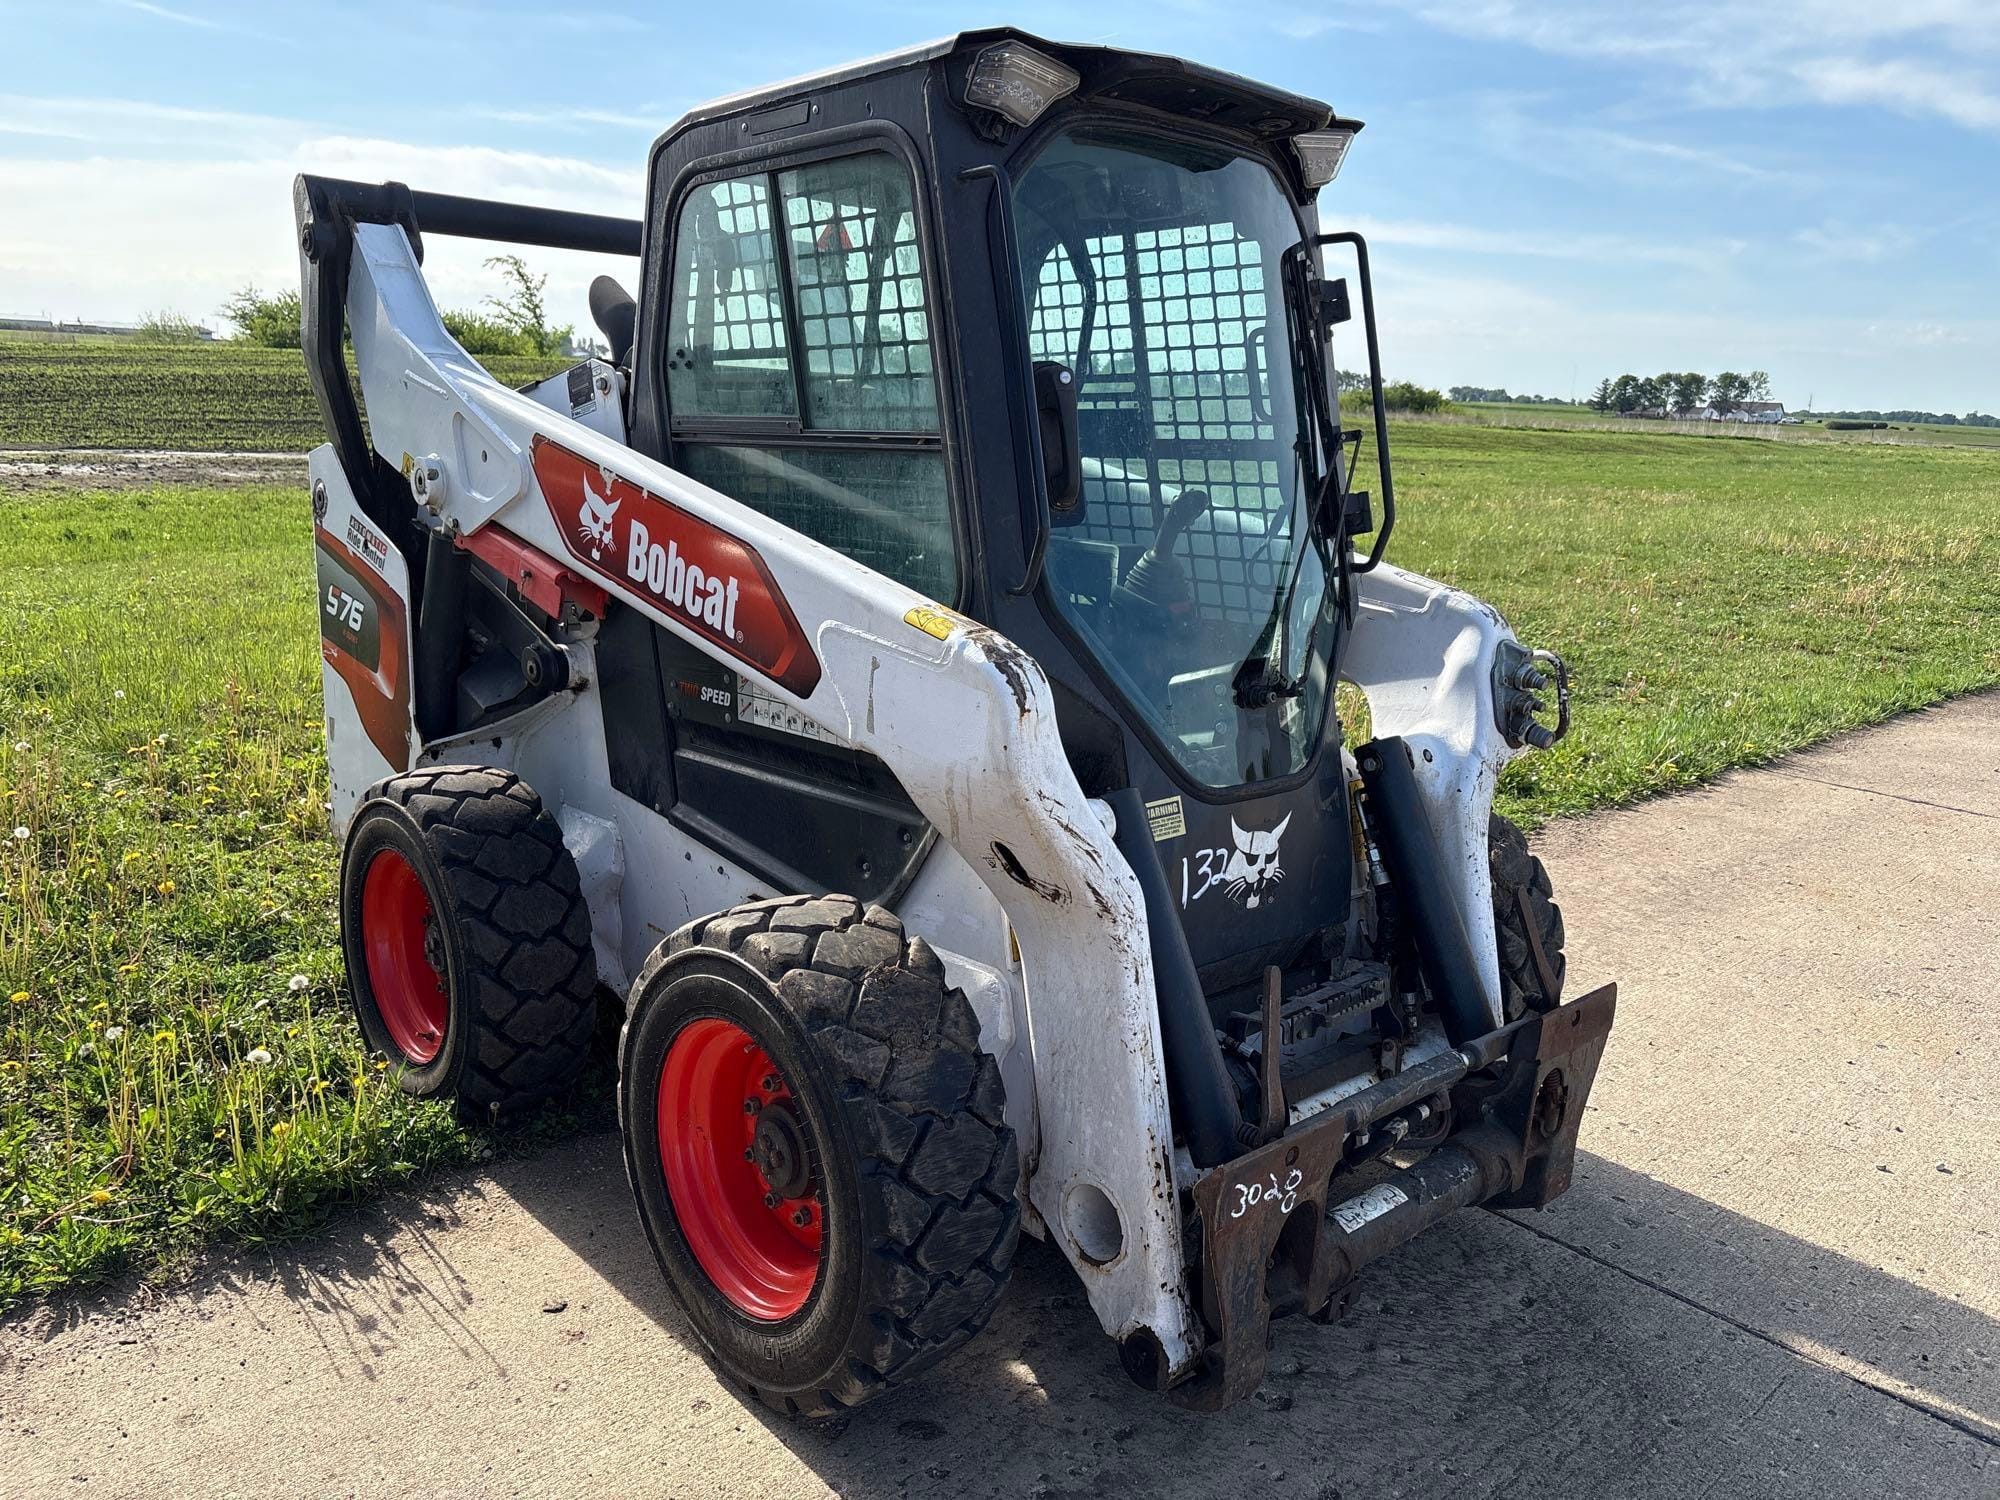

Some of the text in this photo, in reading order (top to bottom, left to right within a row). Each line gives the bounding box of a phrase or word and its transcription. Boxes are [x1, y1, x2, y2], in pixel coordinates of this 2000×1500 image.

[347, 528, 386, 571] Ride Control
[350, 516, 387, 555] AUTOMATIC
[627, 518, 739, 640] Bobcat
[326, 584, 365, 632] S76
[700, 686, 731, 707] SPEED
[1182, 847, 1232, 910] 132
